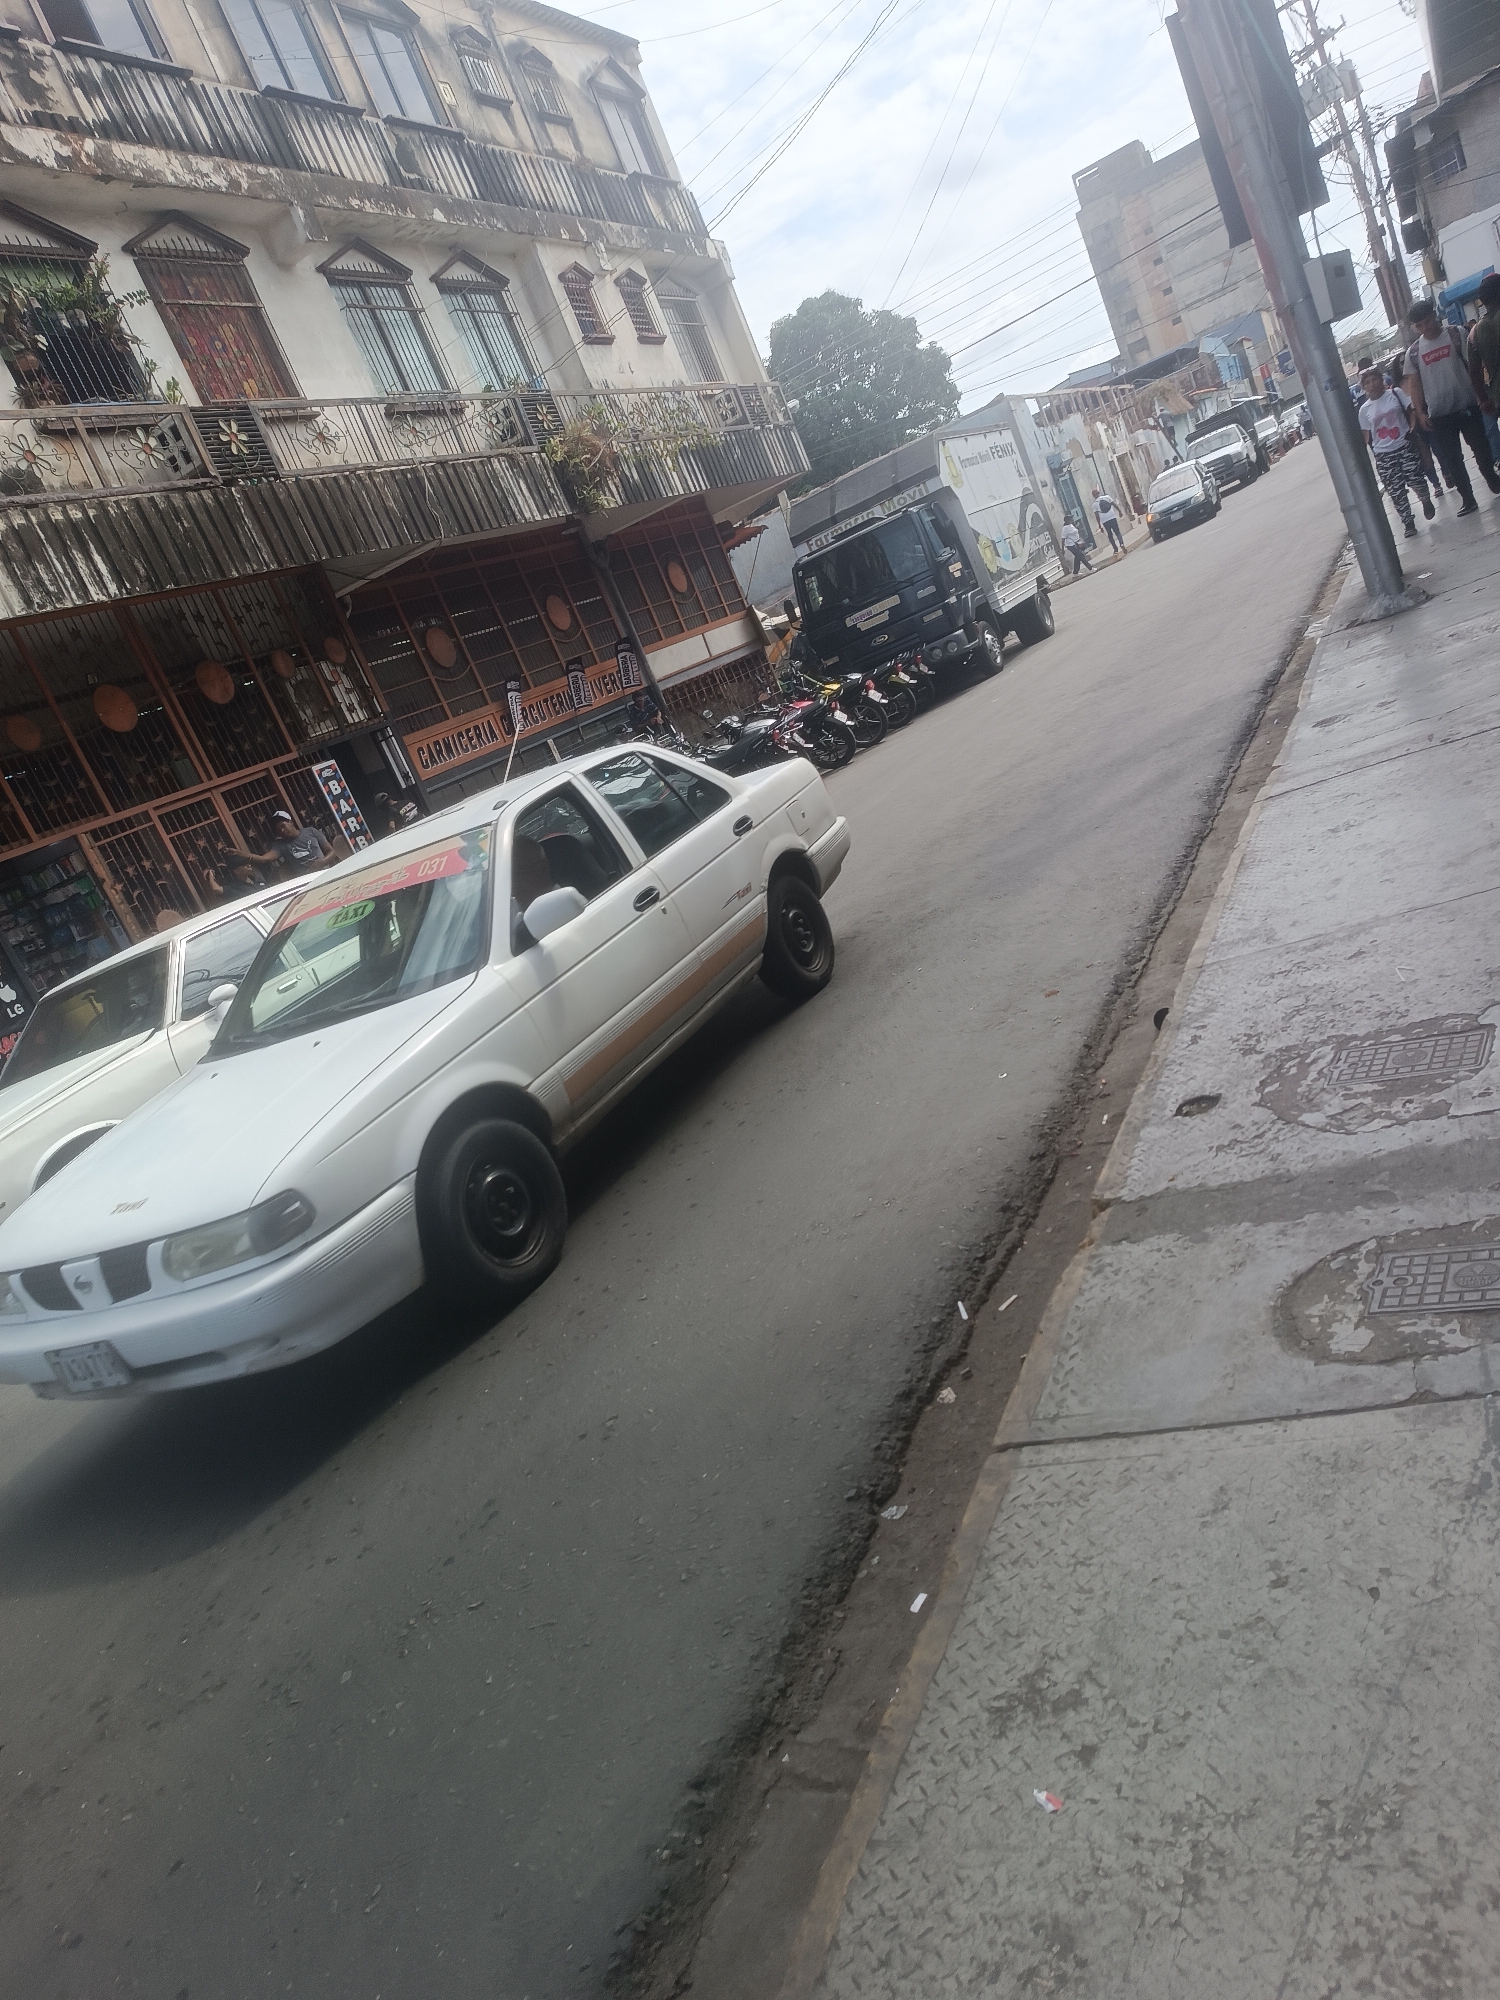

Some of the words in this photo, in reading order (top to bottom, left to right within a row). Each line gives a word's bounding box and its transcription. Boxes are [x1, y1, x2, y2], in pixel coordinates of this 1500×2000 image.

[989, 442, 1017, 461] FÉNIX
[416, 720, 501, 771] CARNICERIA
[417, 856, 448, 878] 031
[332, 903, 369, 926] TAXI
[6, 1003, 25, 1019] LG
